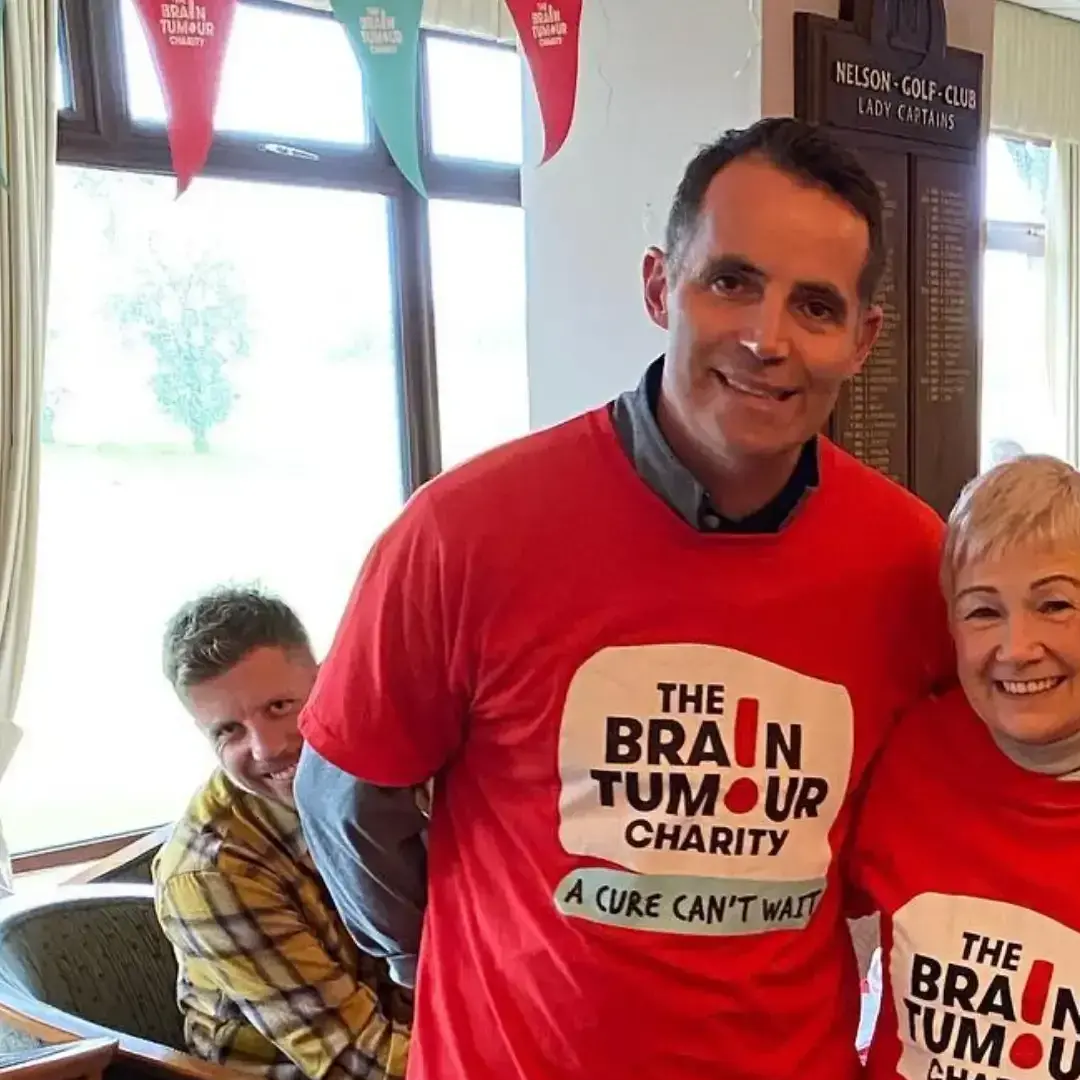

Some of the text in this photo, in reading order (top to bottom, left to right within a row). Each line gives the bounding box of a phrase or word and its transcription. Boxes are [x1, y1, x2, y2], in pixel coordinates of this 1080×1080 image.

[159, 19, 215, 36] TUMOUR
[836, 60, 976, 110] NELSON GOLF CLUB
[858, 97, 955, 131] LADY CAPTAINS
[657, 682, 725, 715] THE
[605, 697, 801, 770] BRAIN
[590, 769, 828, 822] TUMOUR
[624, 818, 789, 857] CHARITY
[564, 878, 823, 924] A CURE CAN'T WAIT
[962, 931, 1023, 971] THE
